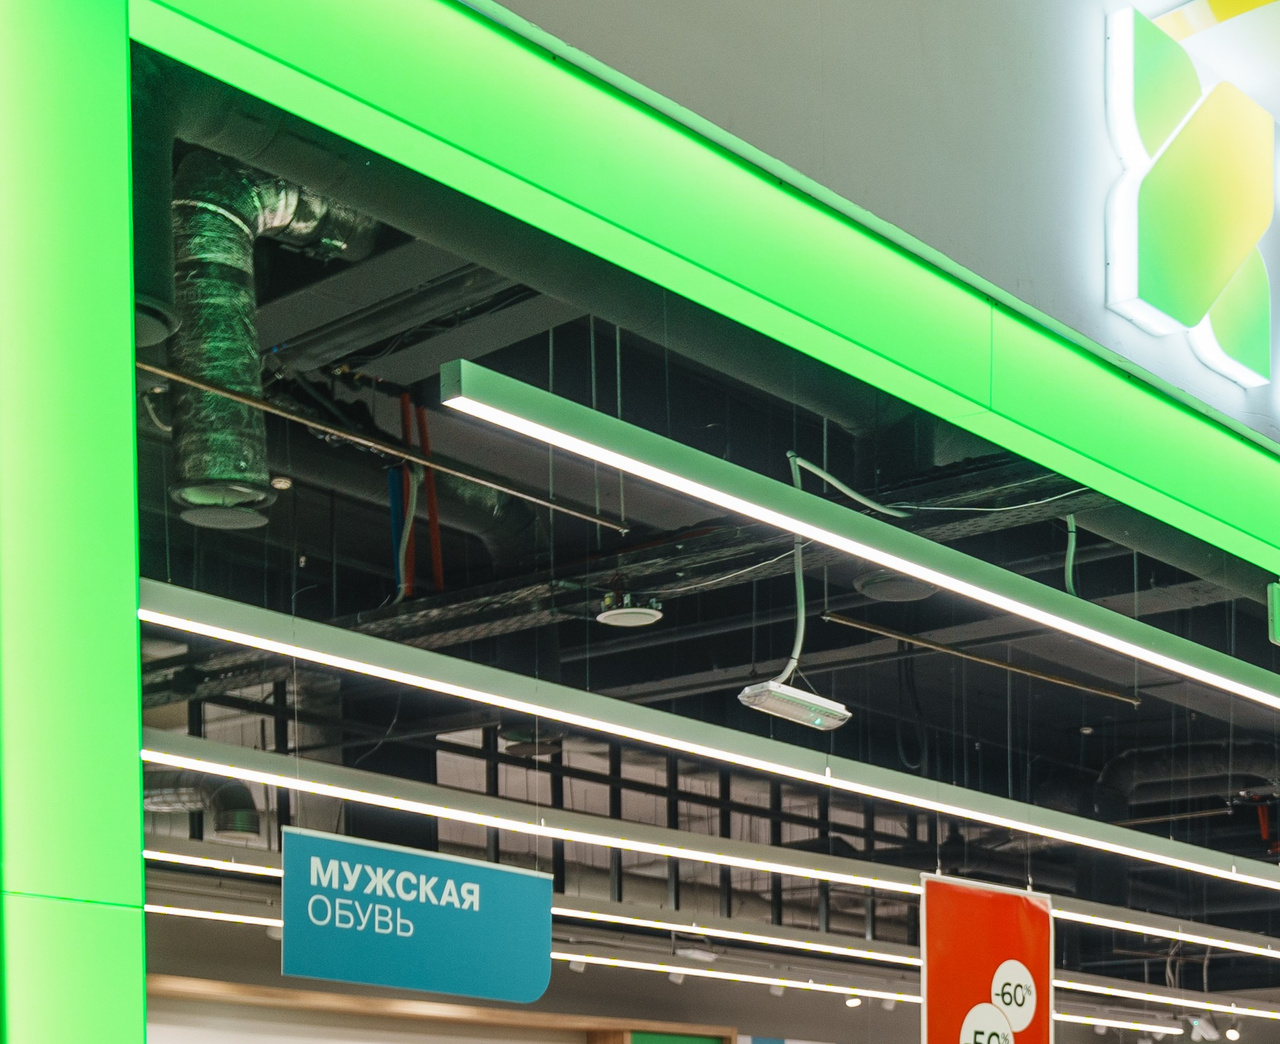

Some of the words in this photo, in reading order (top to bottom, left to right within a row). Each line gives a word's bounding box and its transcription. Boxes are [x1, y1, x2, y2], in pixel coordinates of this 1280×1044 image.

[309, 855, 481, 912] МУЖСКАЯ
[306, 894, 415, 938] ОБУВЬ
[994, 982, 1032, 1008] -60%
